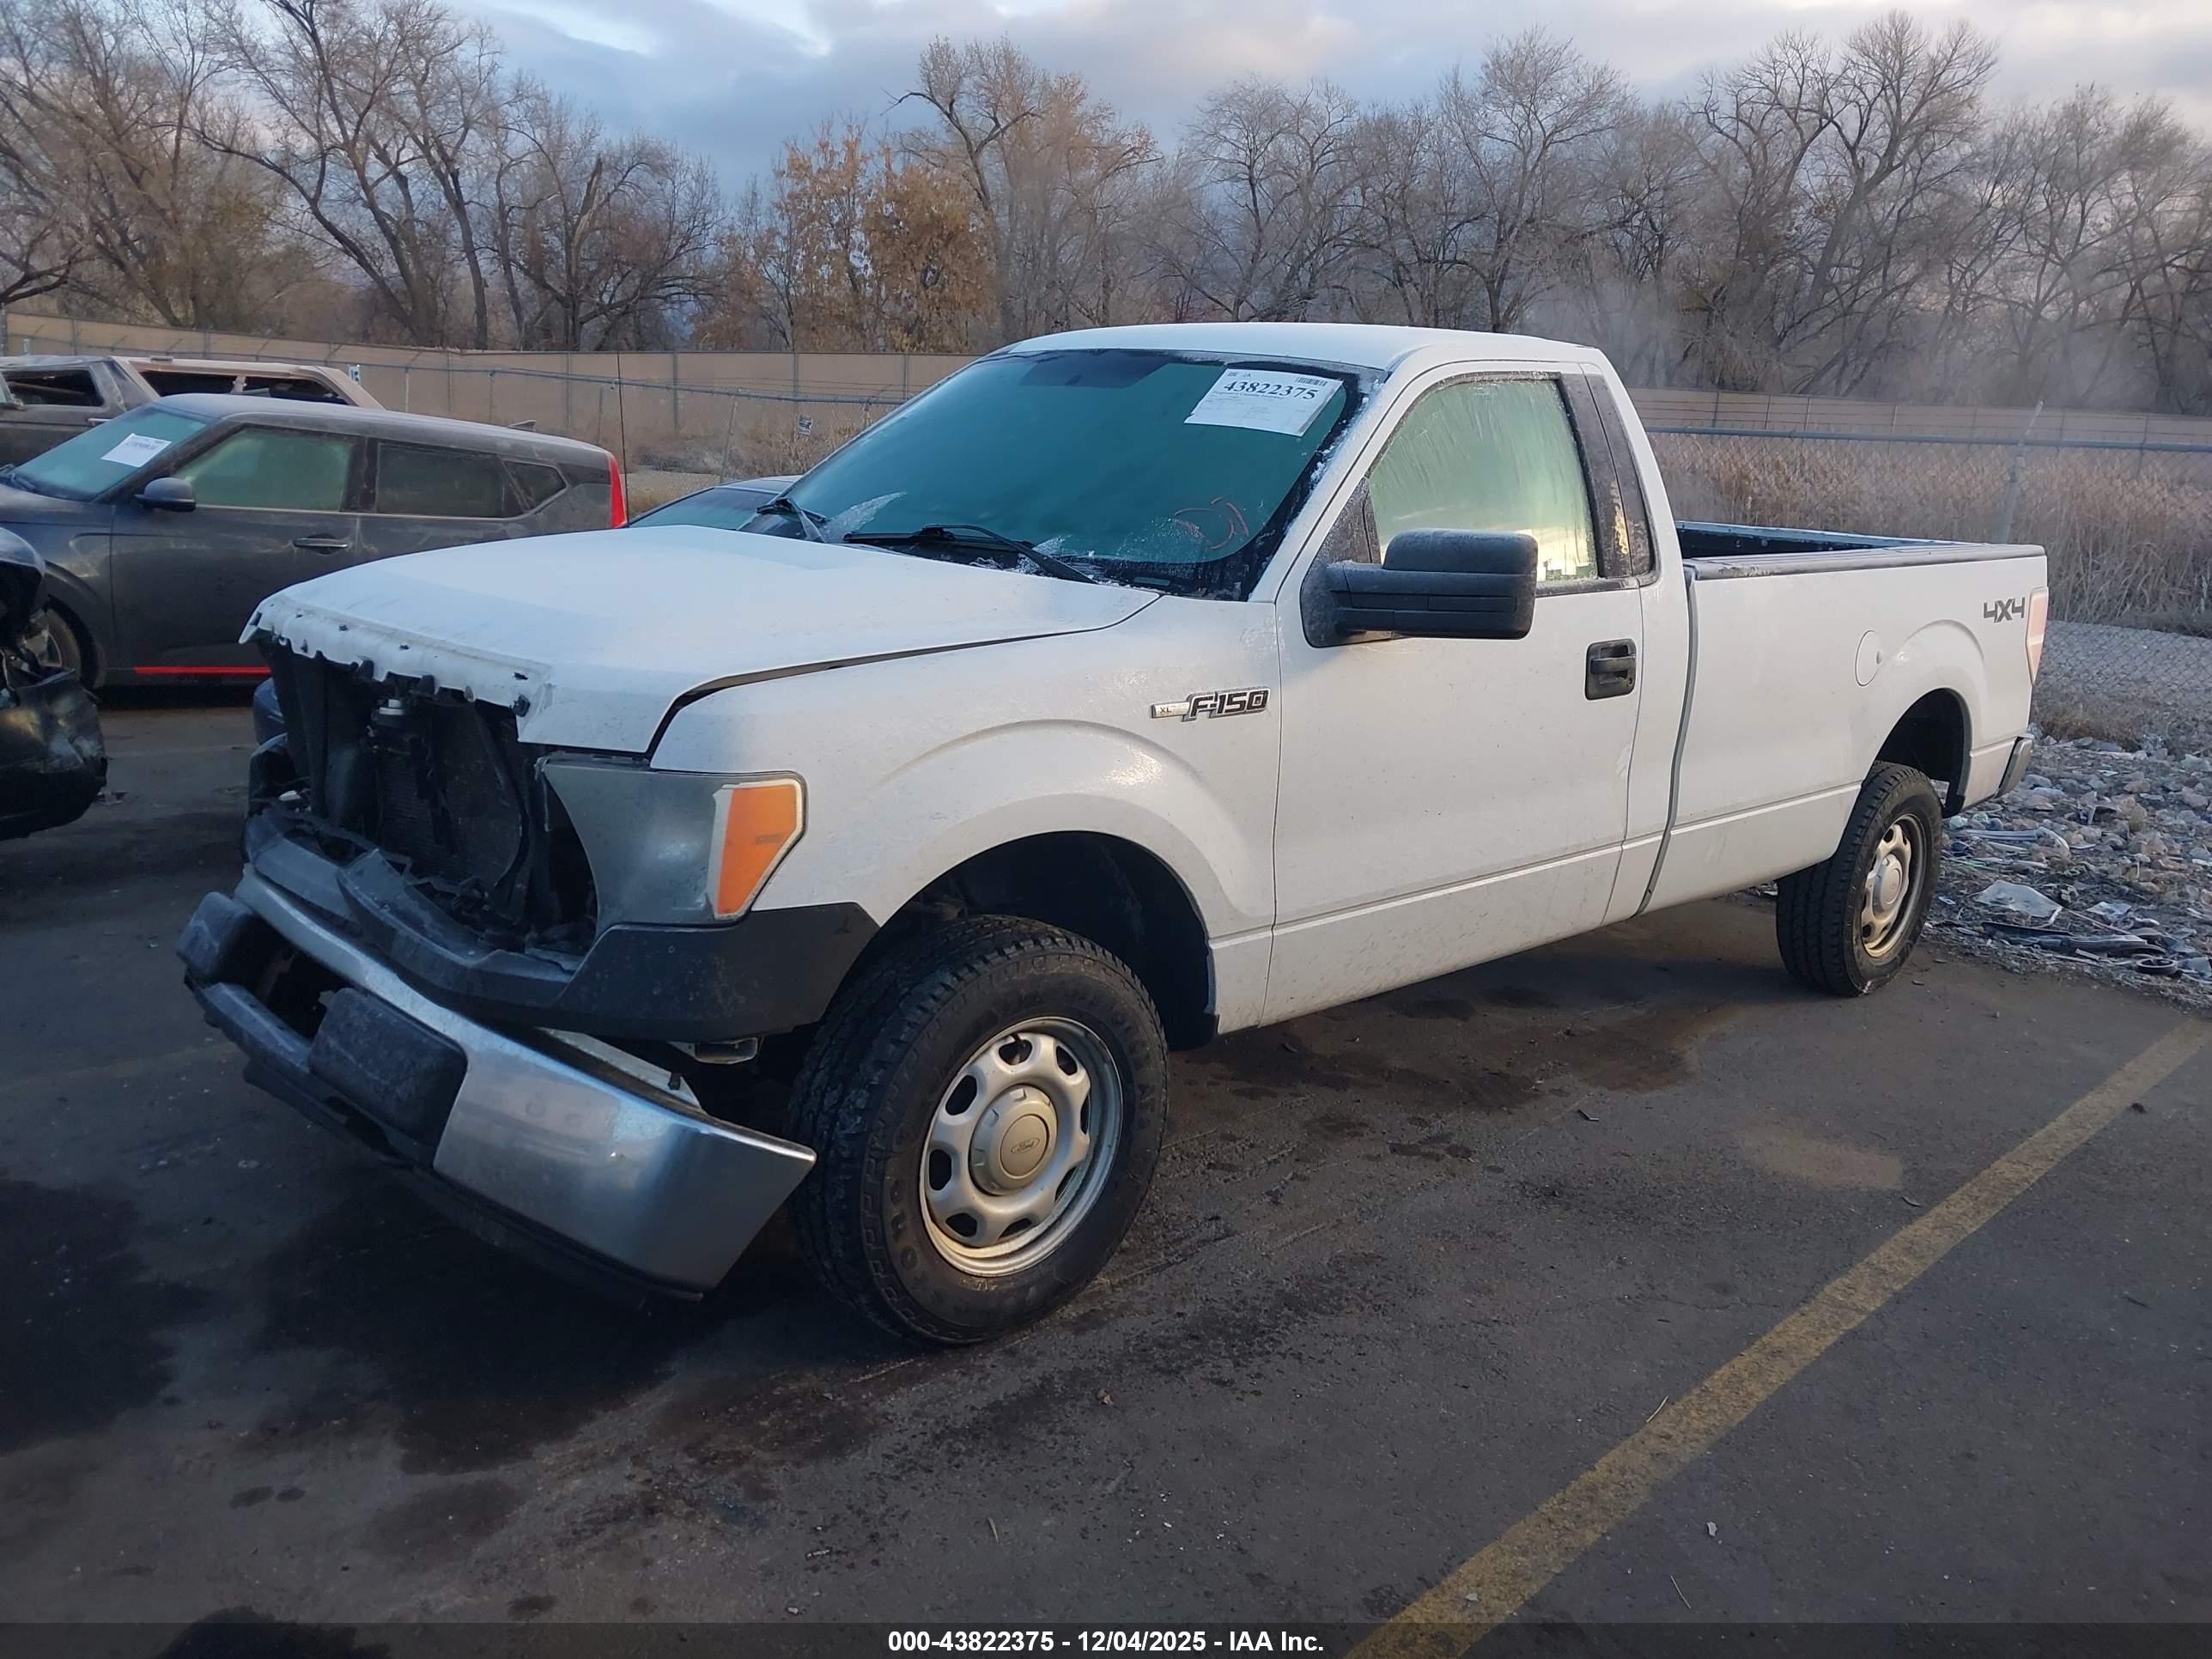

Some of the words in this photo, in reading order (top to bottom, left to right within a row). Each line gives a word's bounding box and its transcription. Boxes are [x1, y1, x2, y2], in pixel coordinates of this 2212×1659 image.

[1224, 380, 1318, 400] 43822375
[1159, 706, 1172, 714] XL
[1187, 688, 1270, 719] F-150
